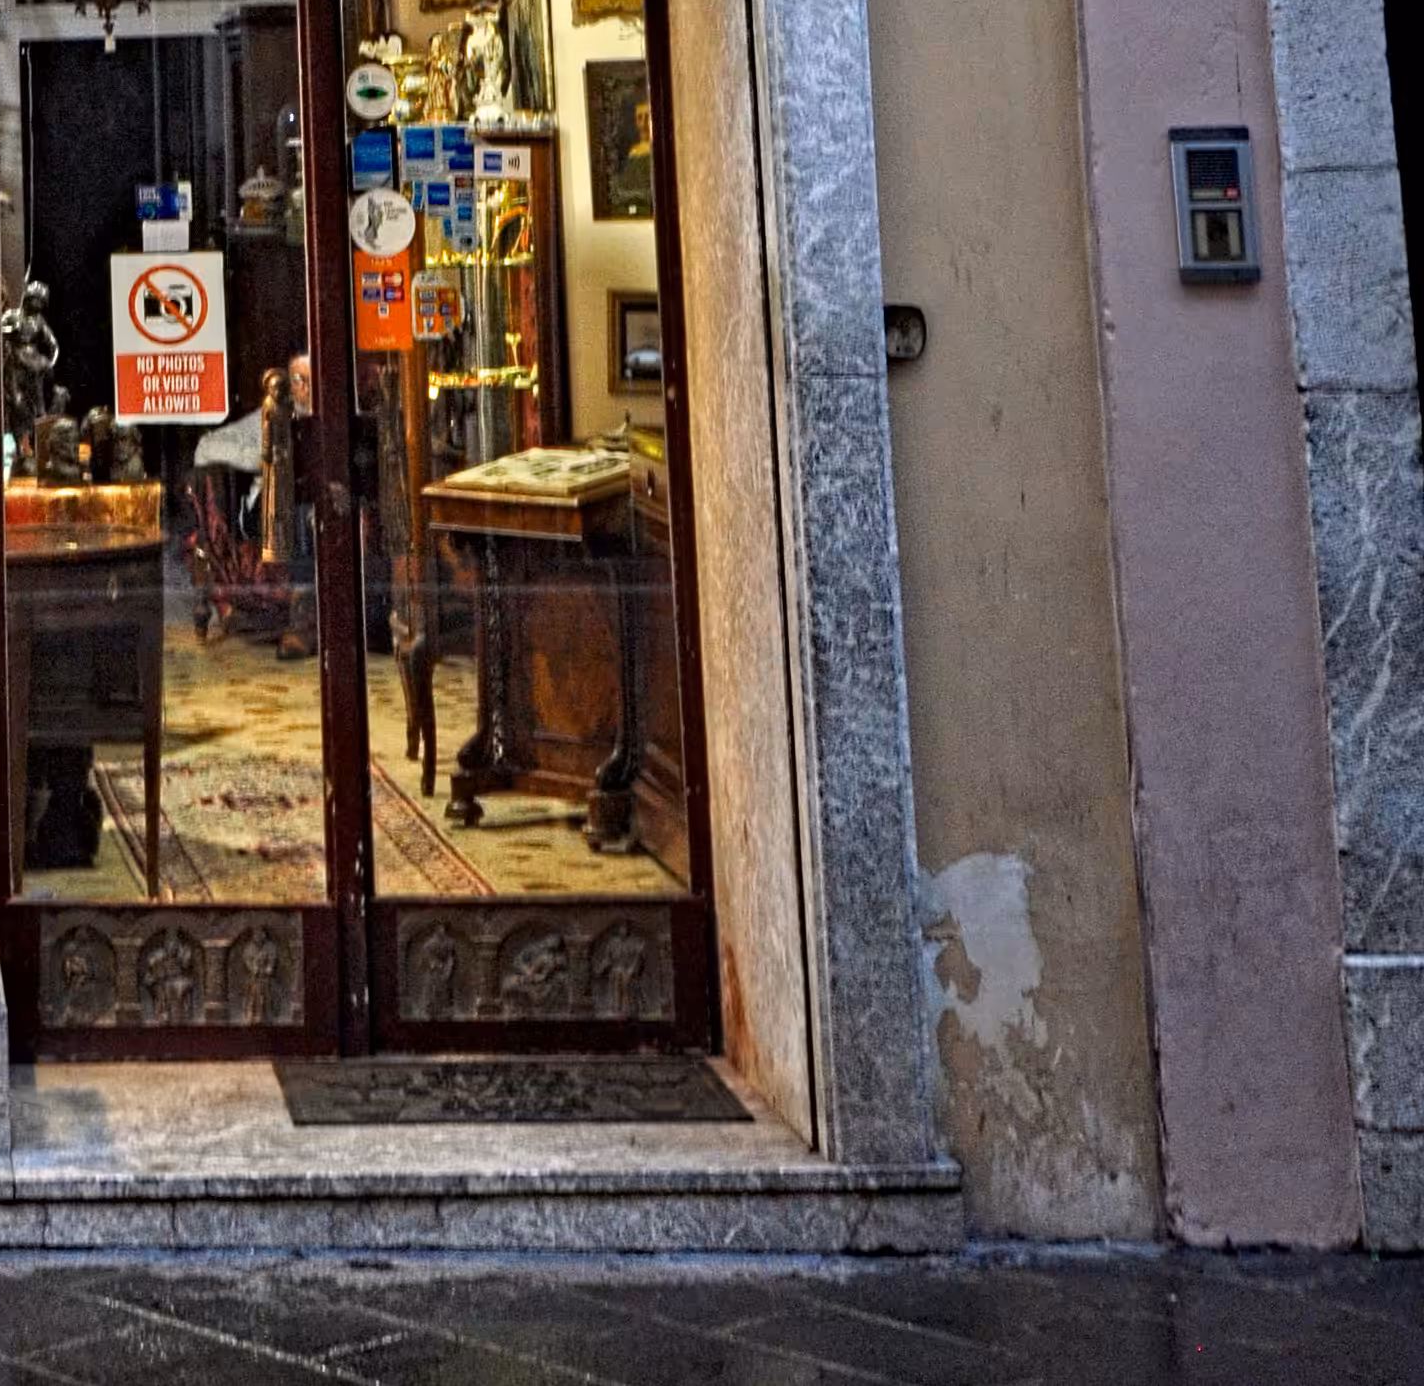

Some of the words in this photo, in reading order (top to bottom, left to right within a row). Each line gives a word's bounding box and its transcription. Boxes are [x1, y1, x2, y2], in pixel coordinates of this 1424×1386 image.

[137, 355, 154, 374] NO
[158, 354, 205, 374] PHOTOS
[143, 375, 160, 393] OR
[163, 374, 199, 393] VIDEO
[143, 394, 201, 413] ALLOWED
